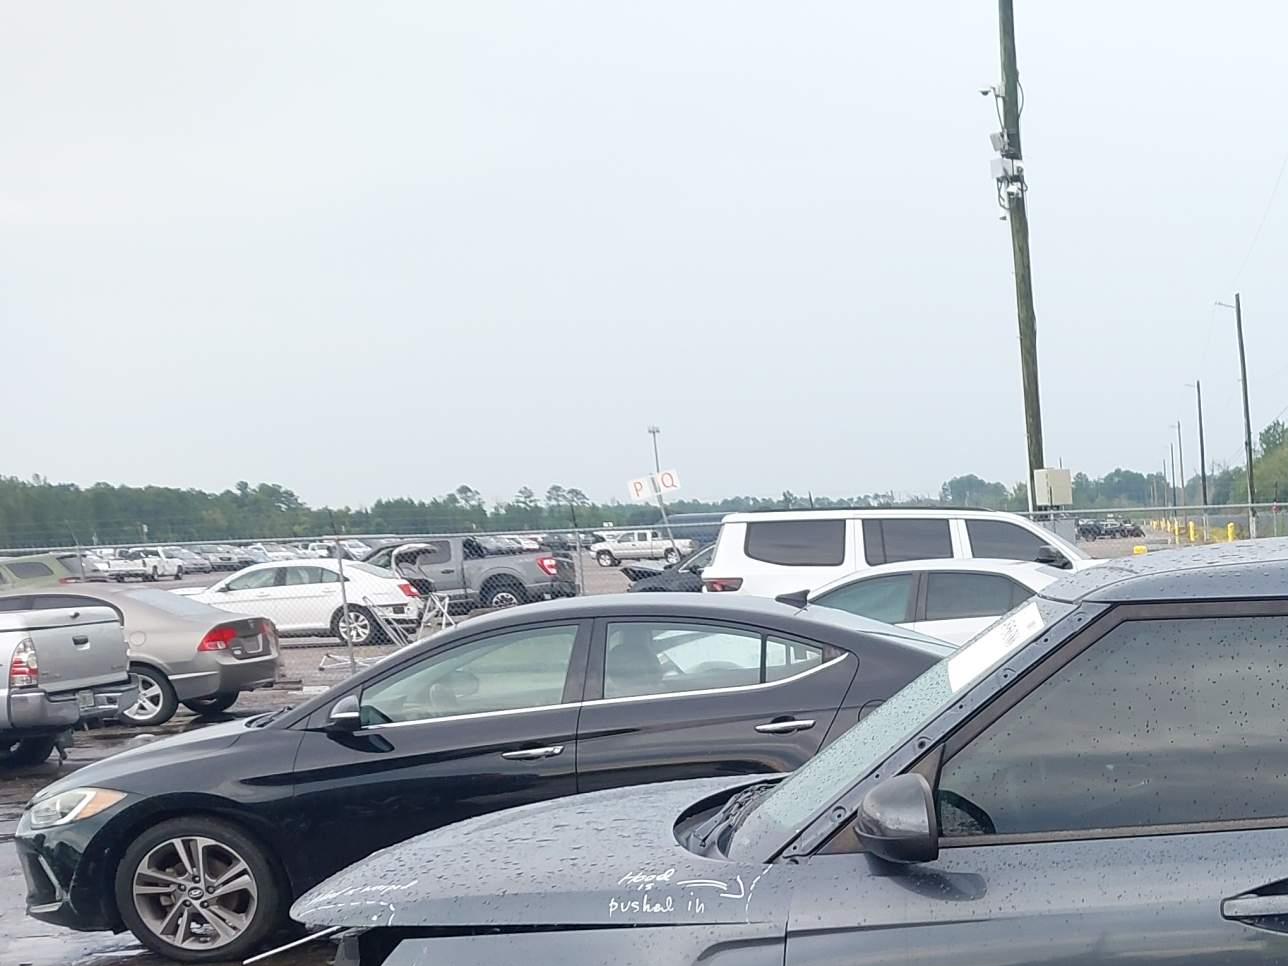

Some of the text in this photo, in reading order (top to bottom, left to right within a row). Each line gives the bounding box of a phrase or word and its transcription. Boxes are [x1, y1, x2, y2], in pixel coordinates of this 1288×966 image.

[633, 481, 643, 497] P
[661, 472, 677, 489] Q
[687, 891, 705, 913] in
